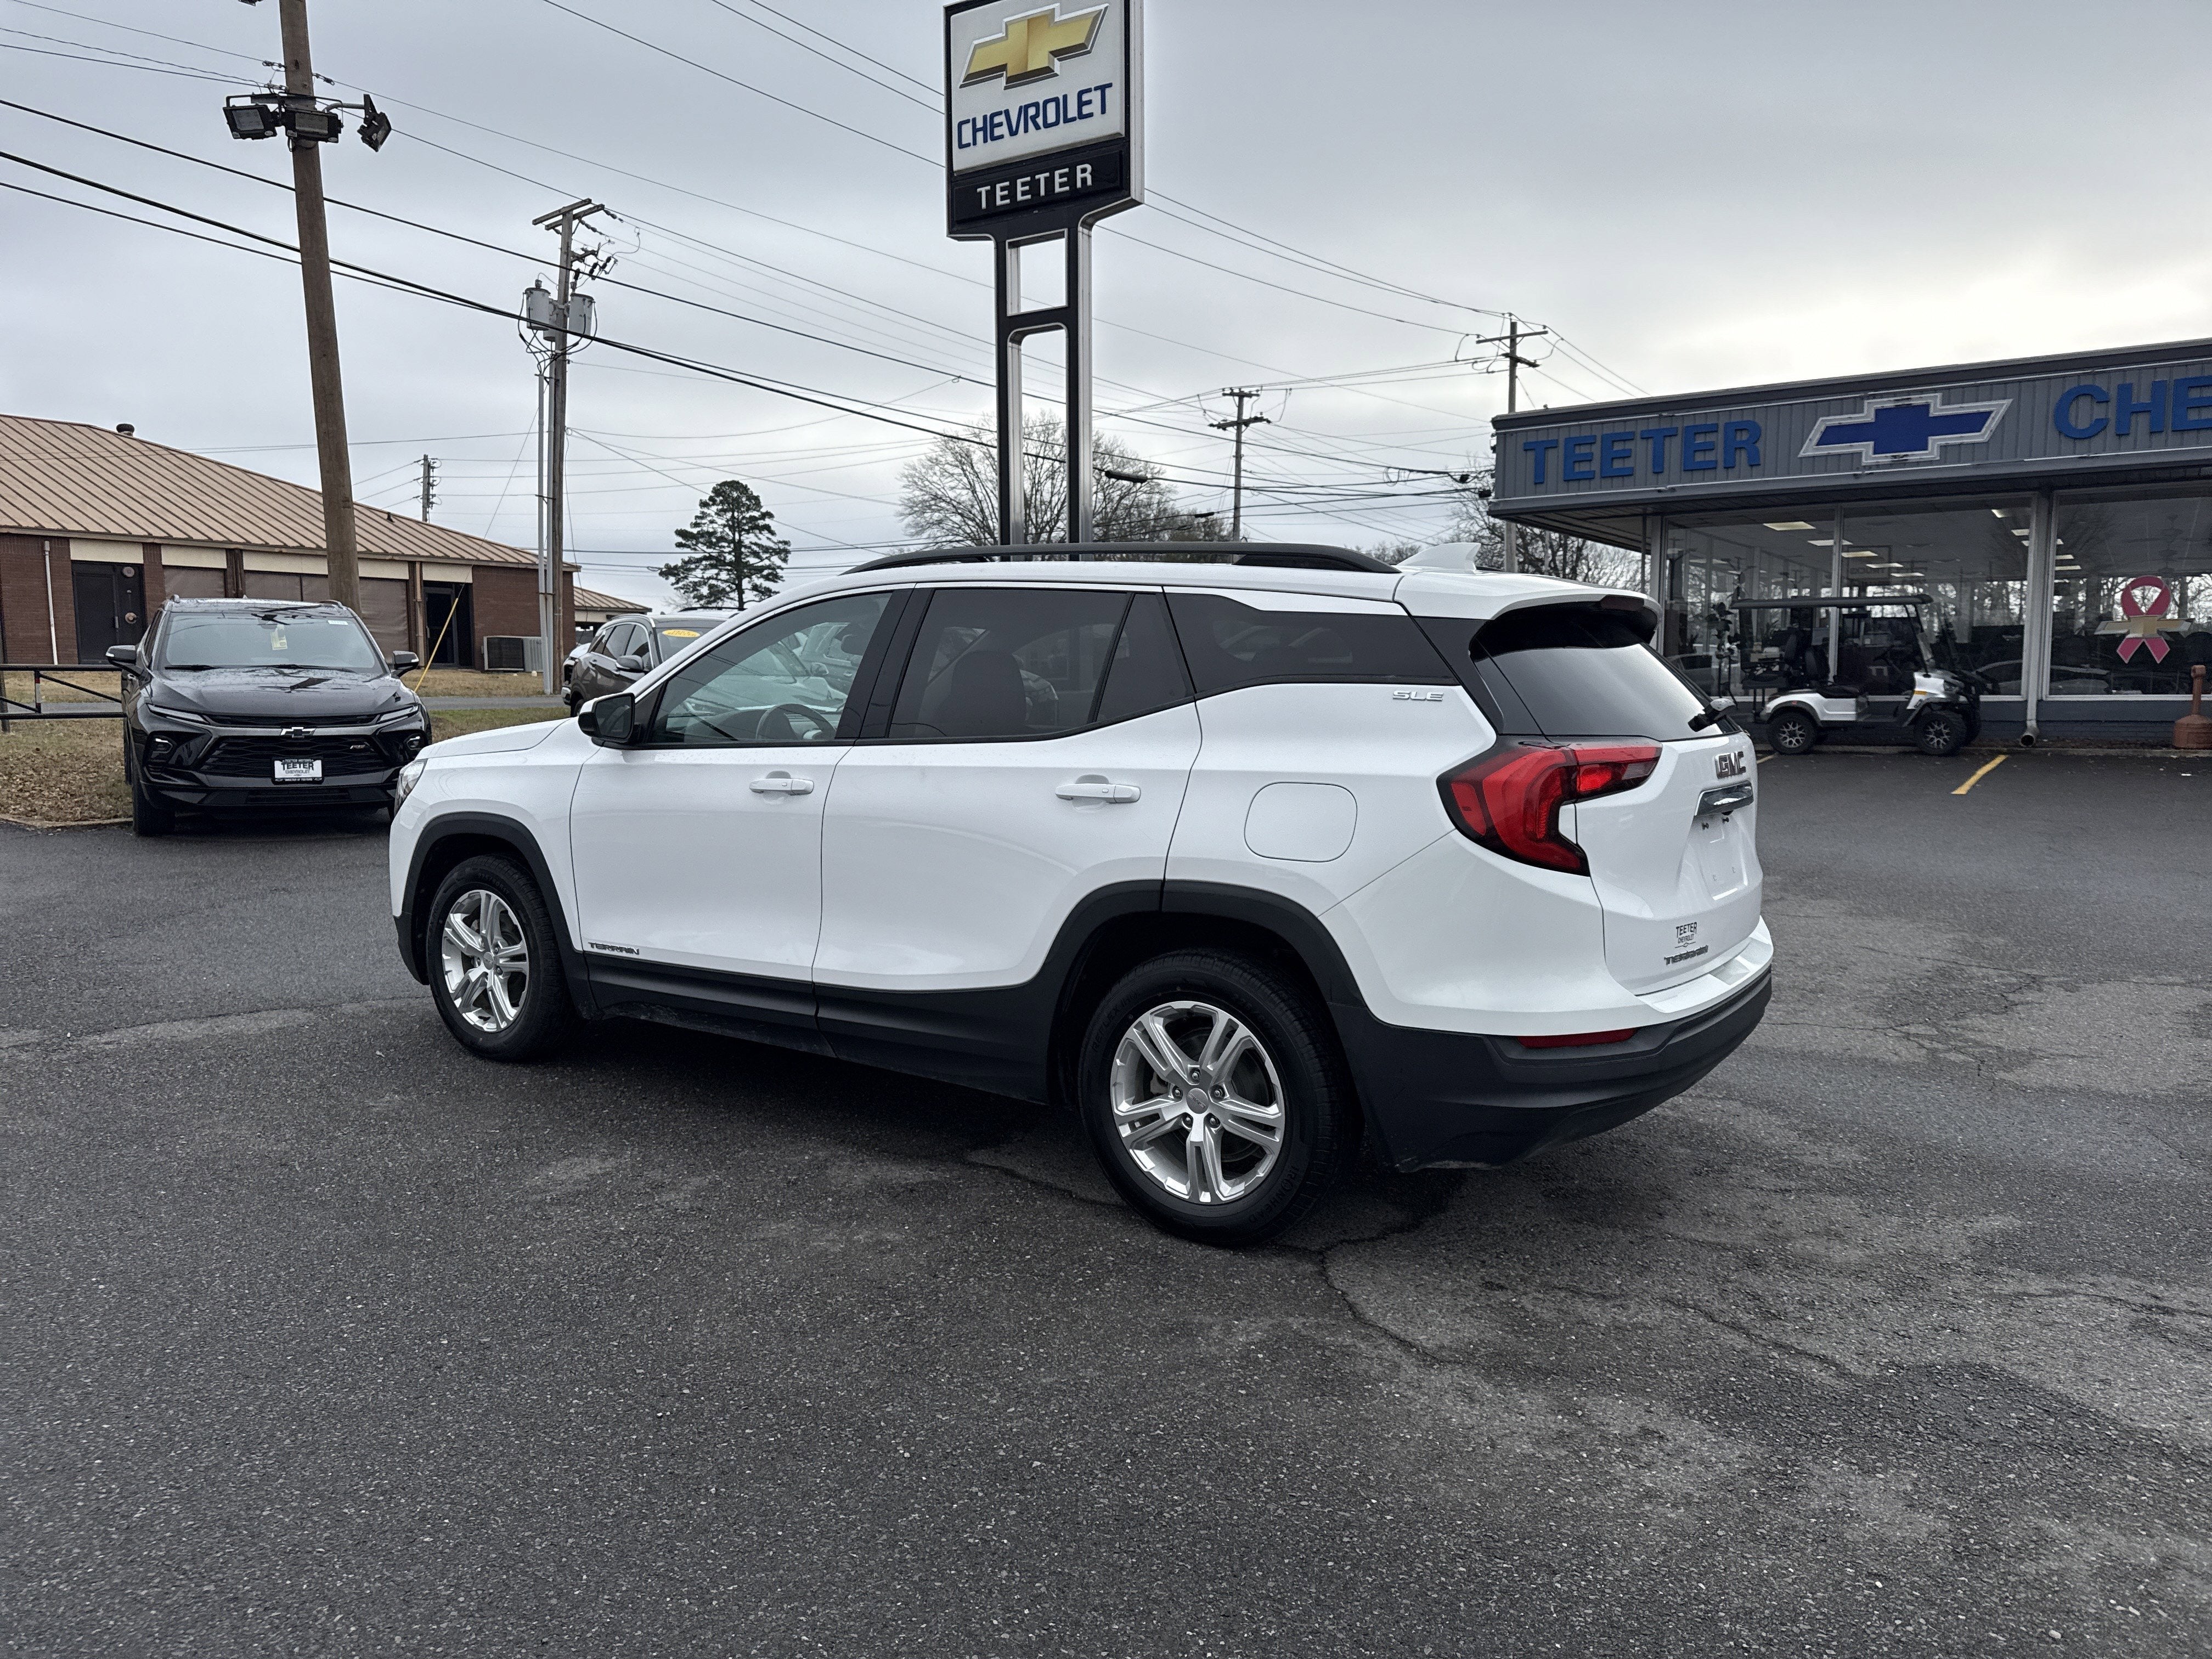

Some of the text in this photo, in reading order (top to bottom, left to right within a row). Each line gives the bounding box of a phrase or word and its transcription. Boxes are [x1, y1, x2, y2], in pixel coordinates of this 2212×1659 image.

[957, 82, 1113, 149] CHEVROLET
[977, 163, 1092, 210] TEETER
[1523, 375, 2212, 485] TEETER CHE
[1393, 691, 1444, 702] SLE
[281, 762, 314, 771] TEETER
[1714, 751, 1747, 780] GMC
[1675, 922, 1697, 939] TEETER
[588, 941, 640, 955] TERRAIN
[1663, 944, 1709, 966] TERRAIN
